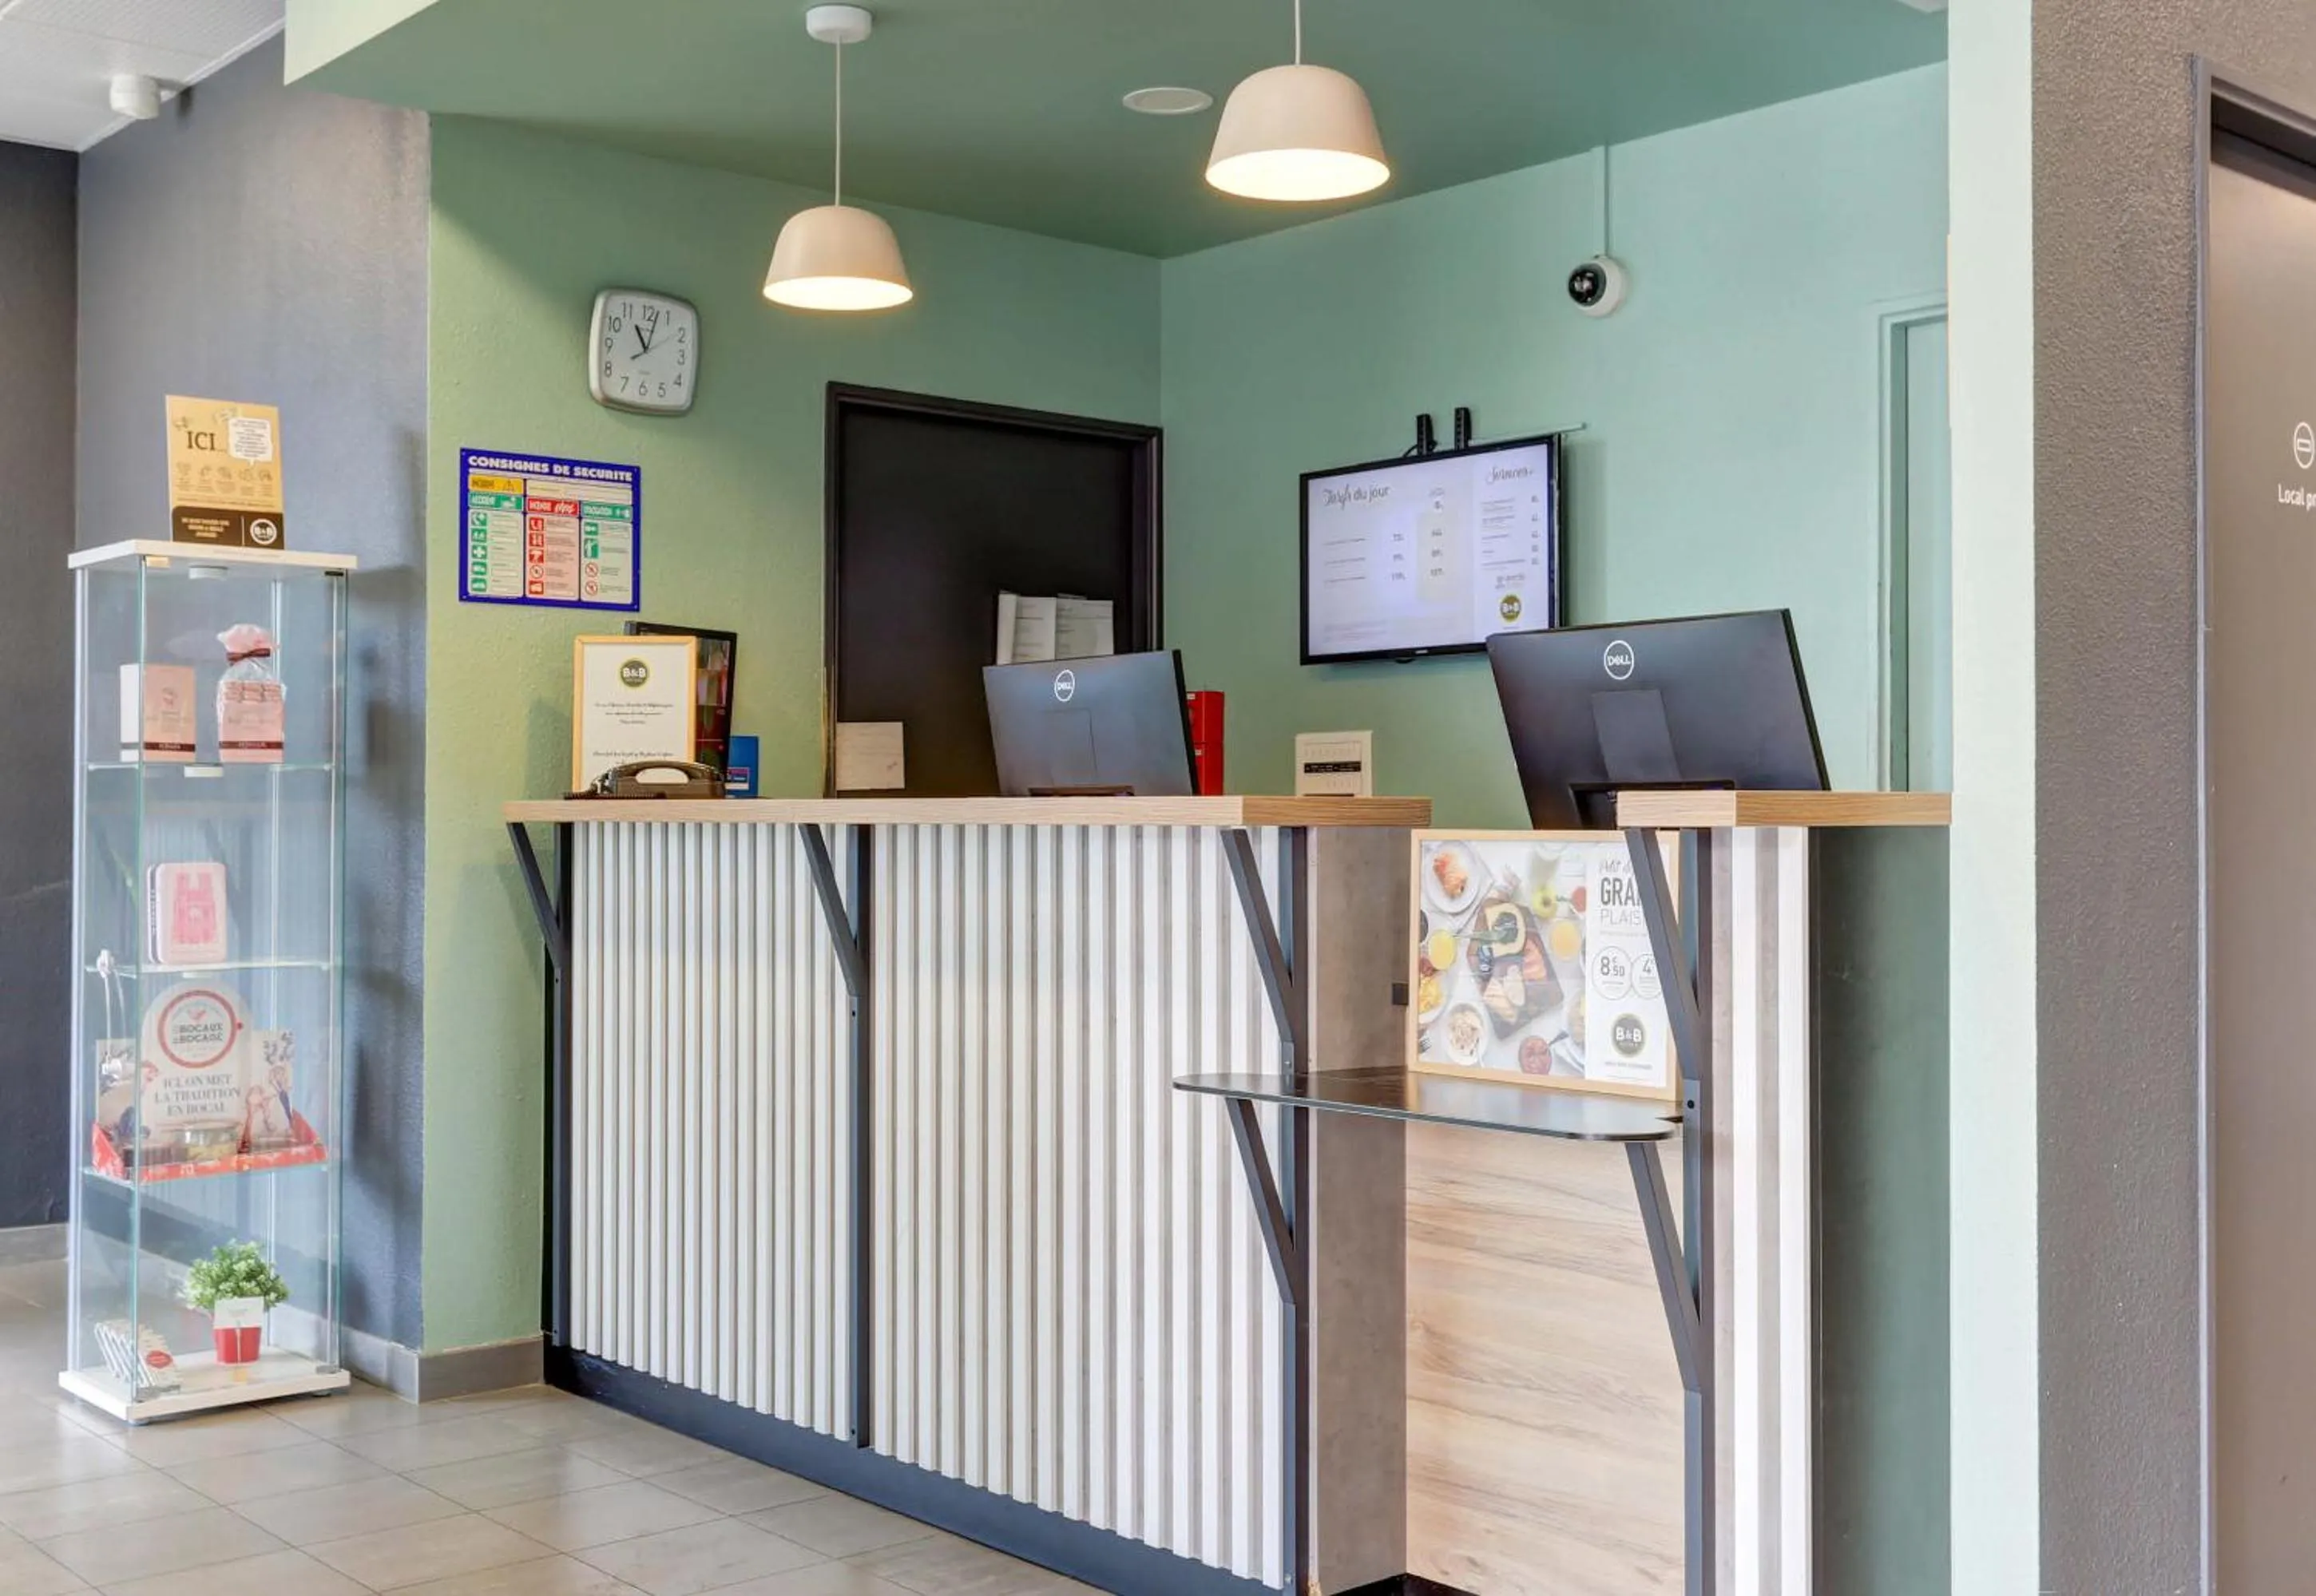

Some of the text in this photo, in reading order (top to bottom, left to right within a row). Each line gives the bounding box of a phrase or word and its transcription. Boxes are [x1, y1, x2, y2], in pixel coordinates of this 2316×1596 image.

[621, 302, 633, 319] 11
[642, 304, 655, 322] 12
[664, 310, 670, 327] 1
[608, 315, 621, 333] 10
[677, 327, 686, 343] 2
[605, 337, 614, 354] 9
[677, 349, 685, 366] 3
[604, 361, 613, 378] 8
[621, 376, 629, 393] 7
[639, 381, 648, 396] 6
[672, 373, 682, 388] 4
[657, 382, 666, 398] 5
[468, 455, 549, 473] CONSIGNES
[553, 464, 570, 476] DE
[2277, 483, 2306, 505] Local
[1607, 654, 1632, 667] DELL
[623, 667, 646, 679] B&B
[1616, 1027, 1642, 1043] B&B
